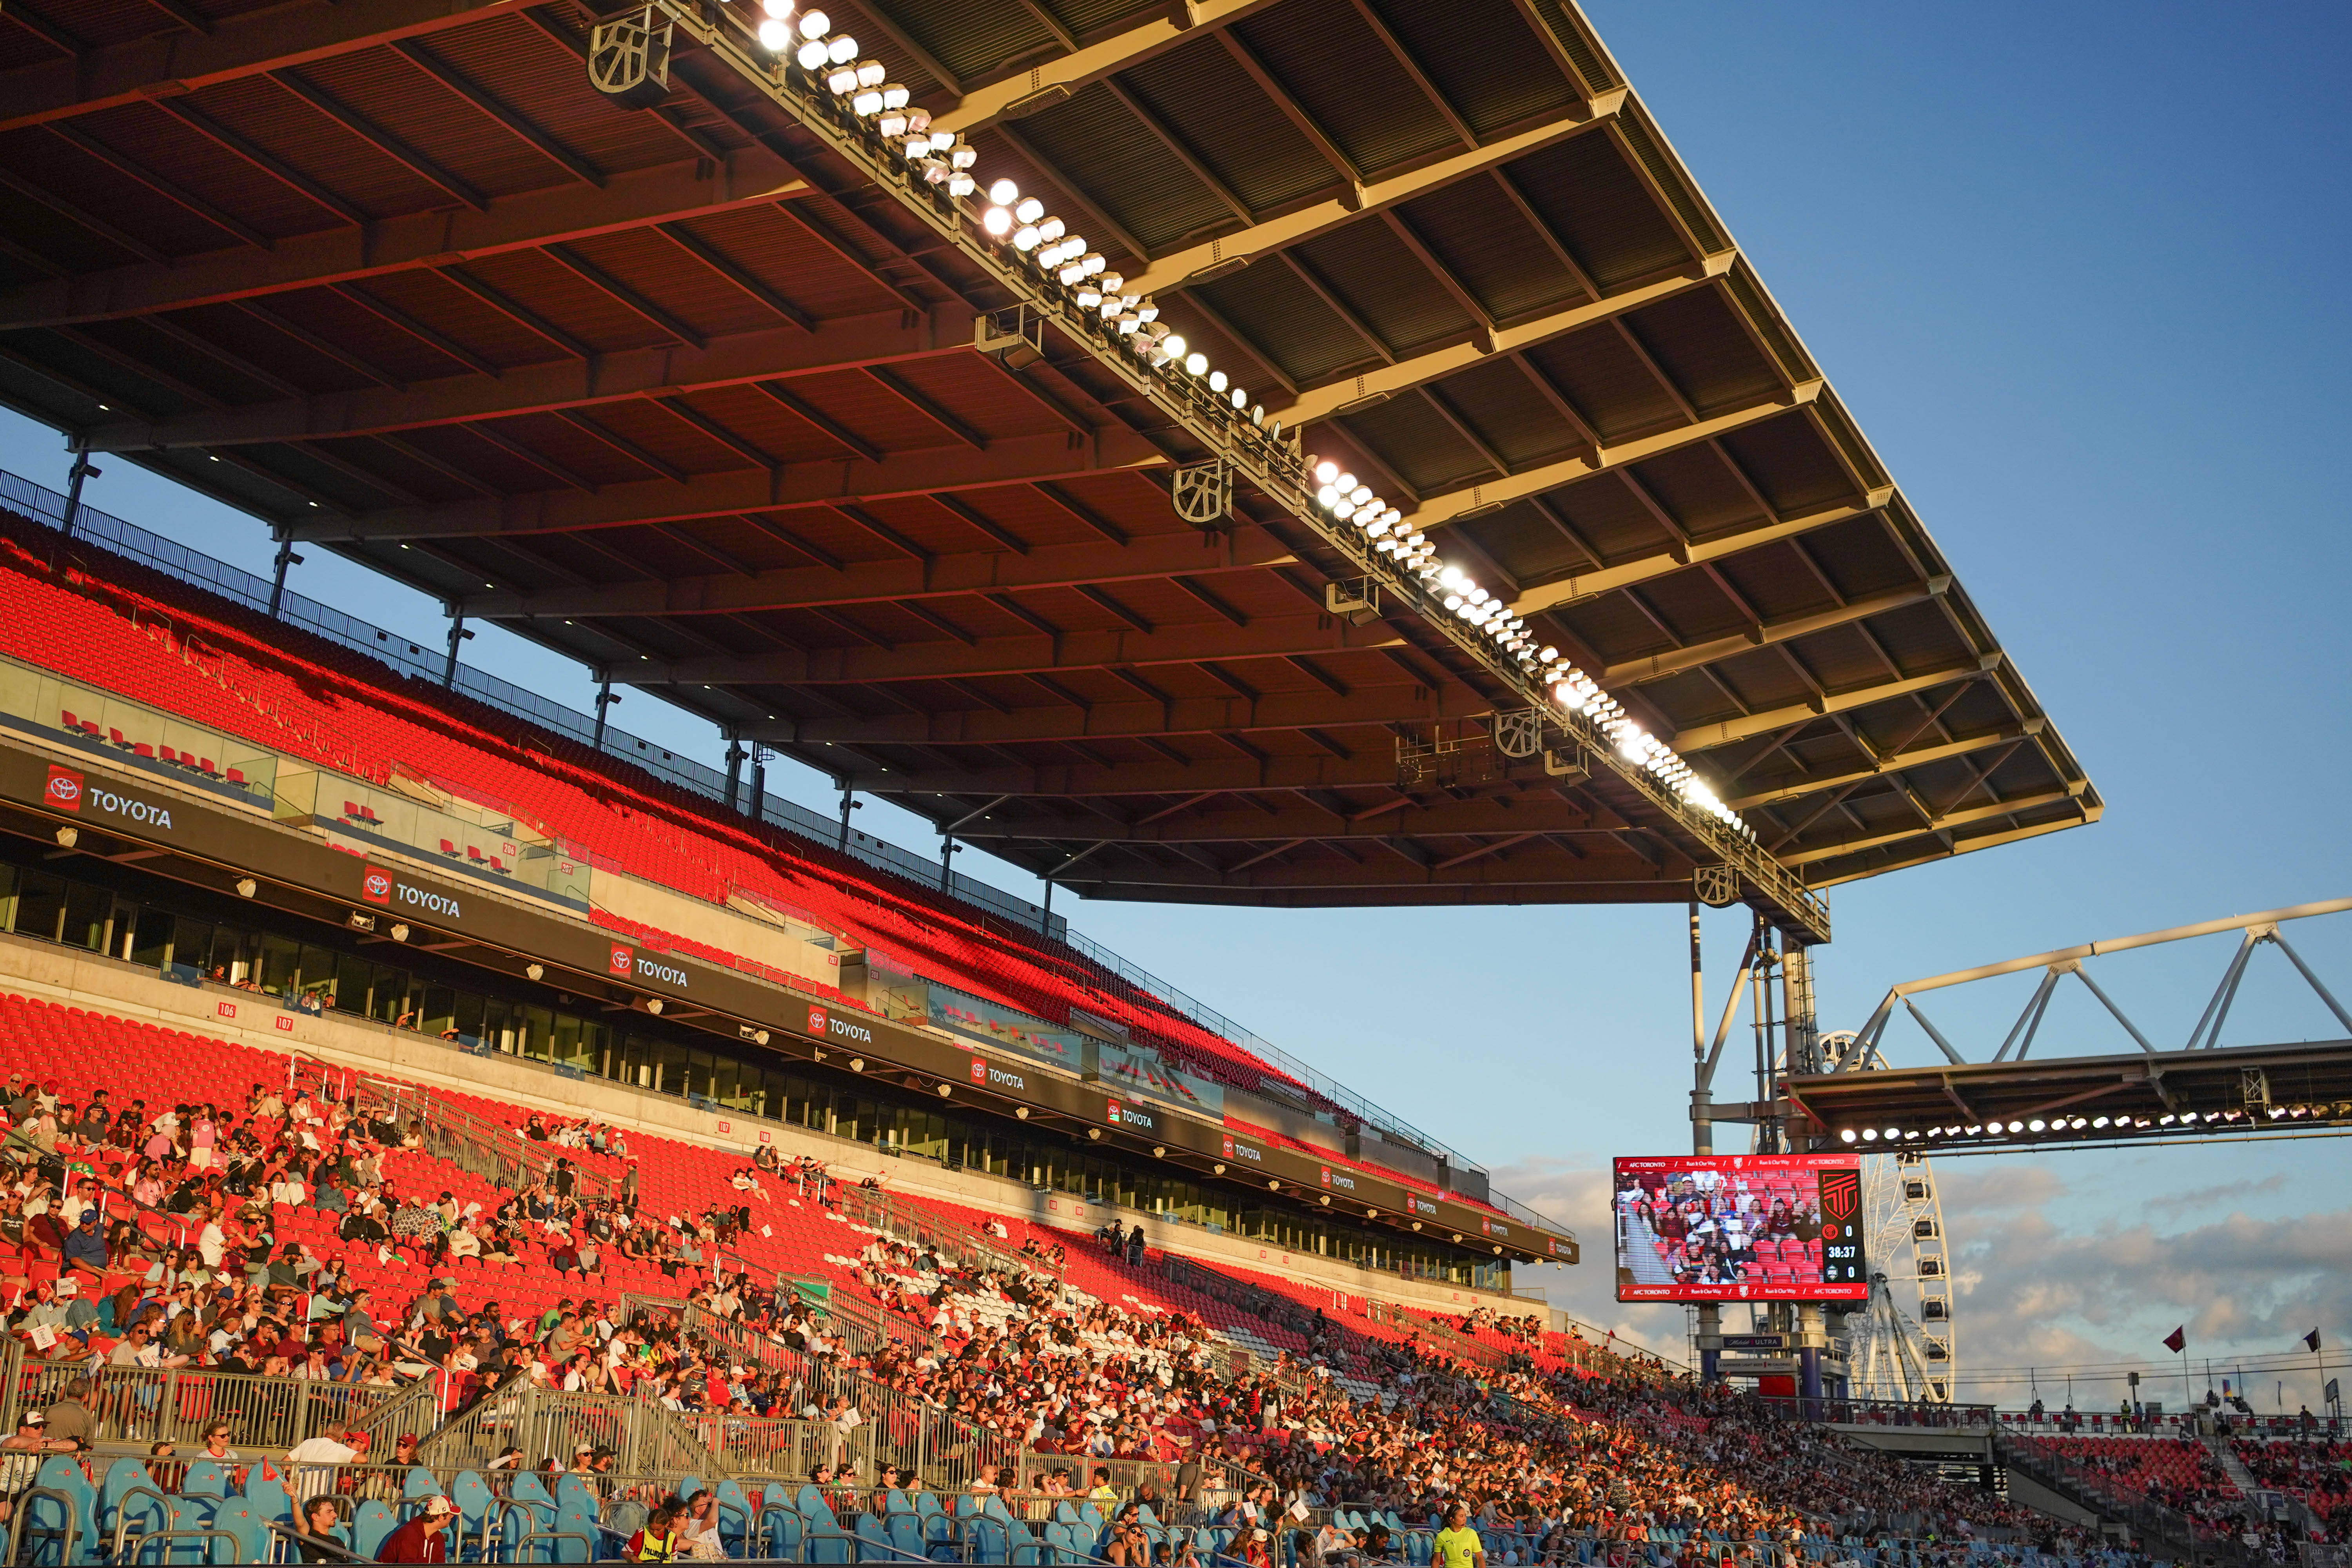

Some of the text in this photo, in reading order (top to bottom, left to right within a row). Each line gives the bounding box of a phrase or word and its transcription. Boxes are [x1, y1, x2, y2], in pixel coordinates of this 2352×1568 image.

[91, 788, 171, 829] TOYOTA
[504, 844, 514, 855] 206
[397, 883, 459, 918] TOYOTA
[637, 958, 687, 987] TOYOTA
[221, 1004, 234, 1016] 106
[278, 1018, 292, 1029] 107
[829, 1018, 871, 1043] TOYOTA
[989, 1068, 1024, 1090] TOYOTA
[1122, 1109, 1152, 1128] TOYOTA
[720, 1122, 729, 1132] 107
[761, 1132, 769, 1142] 108
[1235, 1144, 1261, 1161] TOYOTA
[1332, 1174, 1354, 1190] TOYOTA
[1417, 1200, 1436, 1214] TOYOTA
[1491, 1224, 1508, 1236] TOYOTA
[1846, 1225, 1853, 1237] 0
[1556, 1244, 1571, 1255] TOYOTA
[1828, 1246, 1855, 1258] 38:37
[1848, 1266, 1855, 1278] 0
